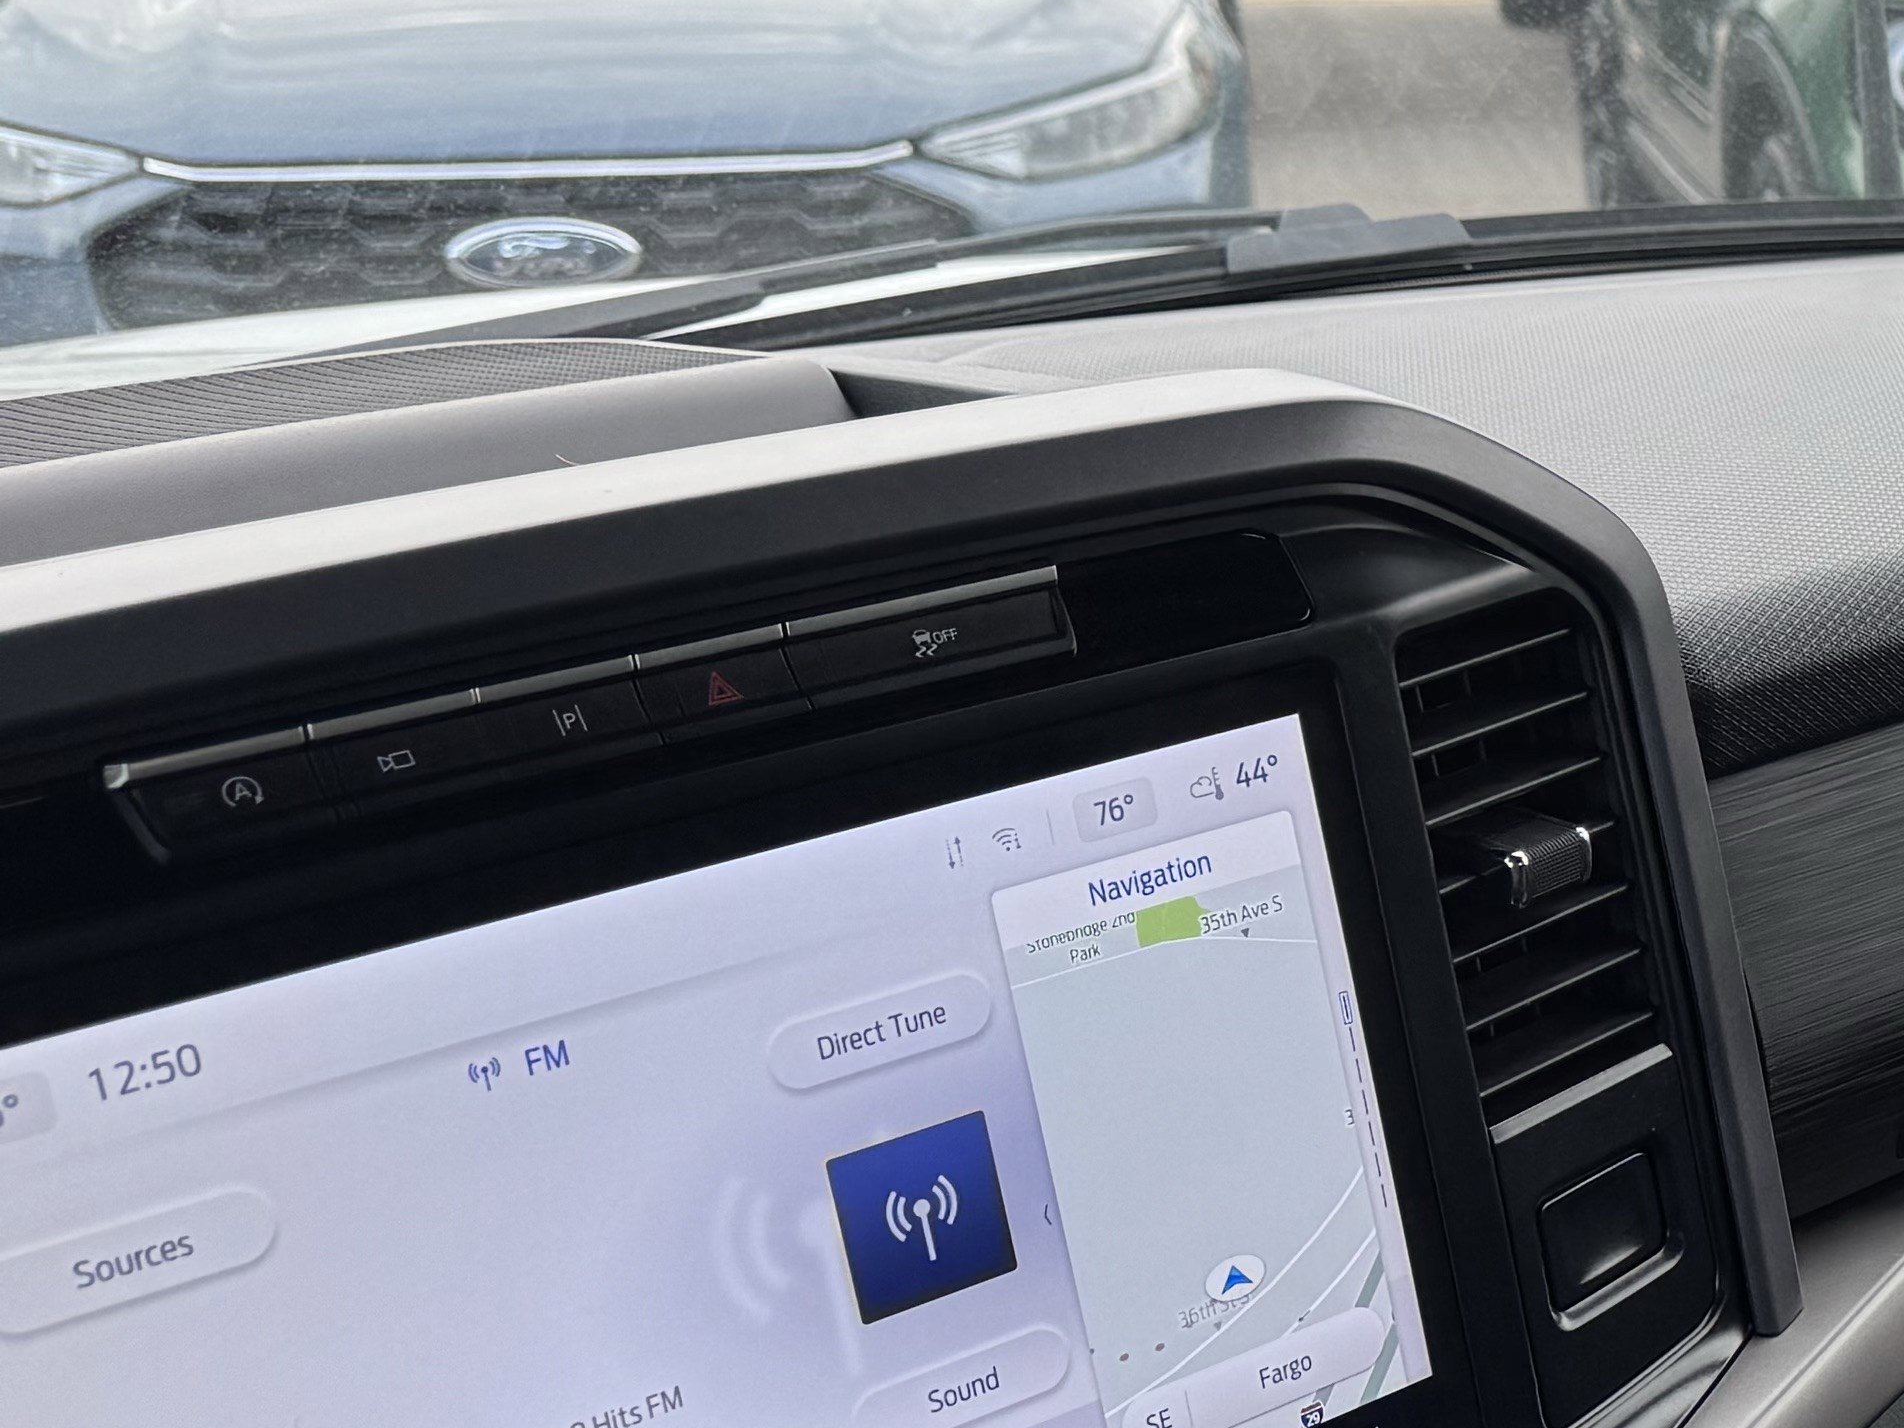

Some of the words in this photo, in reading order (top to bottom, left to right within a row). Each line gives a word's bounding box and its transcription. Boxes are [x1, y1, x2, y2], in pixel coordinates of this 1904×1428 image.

[931, 626, 959, 645] OFF
[1235, 753, 1280, 789] 44°
[1092, 793, 1135, 827] 76°
[1087, 852, 1213, 908] Navigation
[1199, 909, 1240, 935] 35th
[1240, 902, 1270, 924] Ave
[1271, 894, 1284, 914] S
[1069, 943, 1102, 964] Park
[816, 1019, 887, 1062] Direct
[888, 1002, 948, 1039] Tune
[88, 1042, 202, 1102] 12:50
[524, 1039, 571, 1076] FM
[71, 1233, 195, 1289] Sources
[927, 1366, 1001, 1414] Sound
[1259, 1355, 1313, 1390] Fargo
[646, 1384, 685, 1421] FM
[1305, 1410, 1322, 1428] 29
